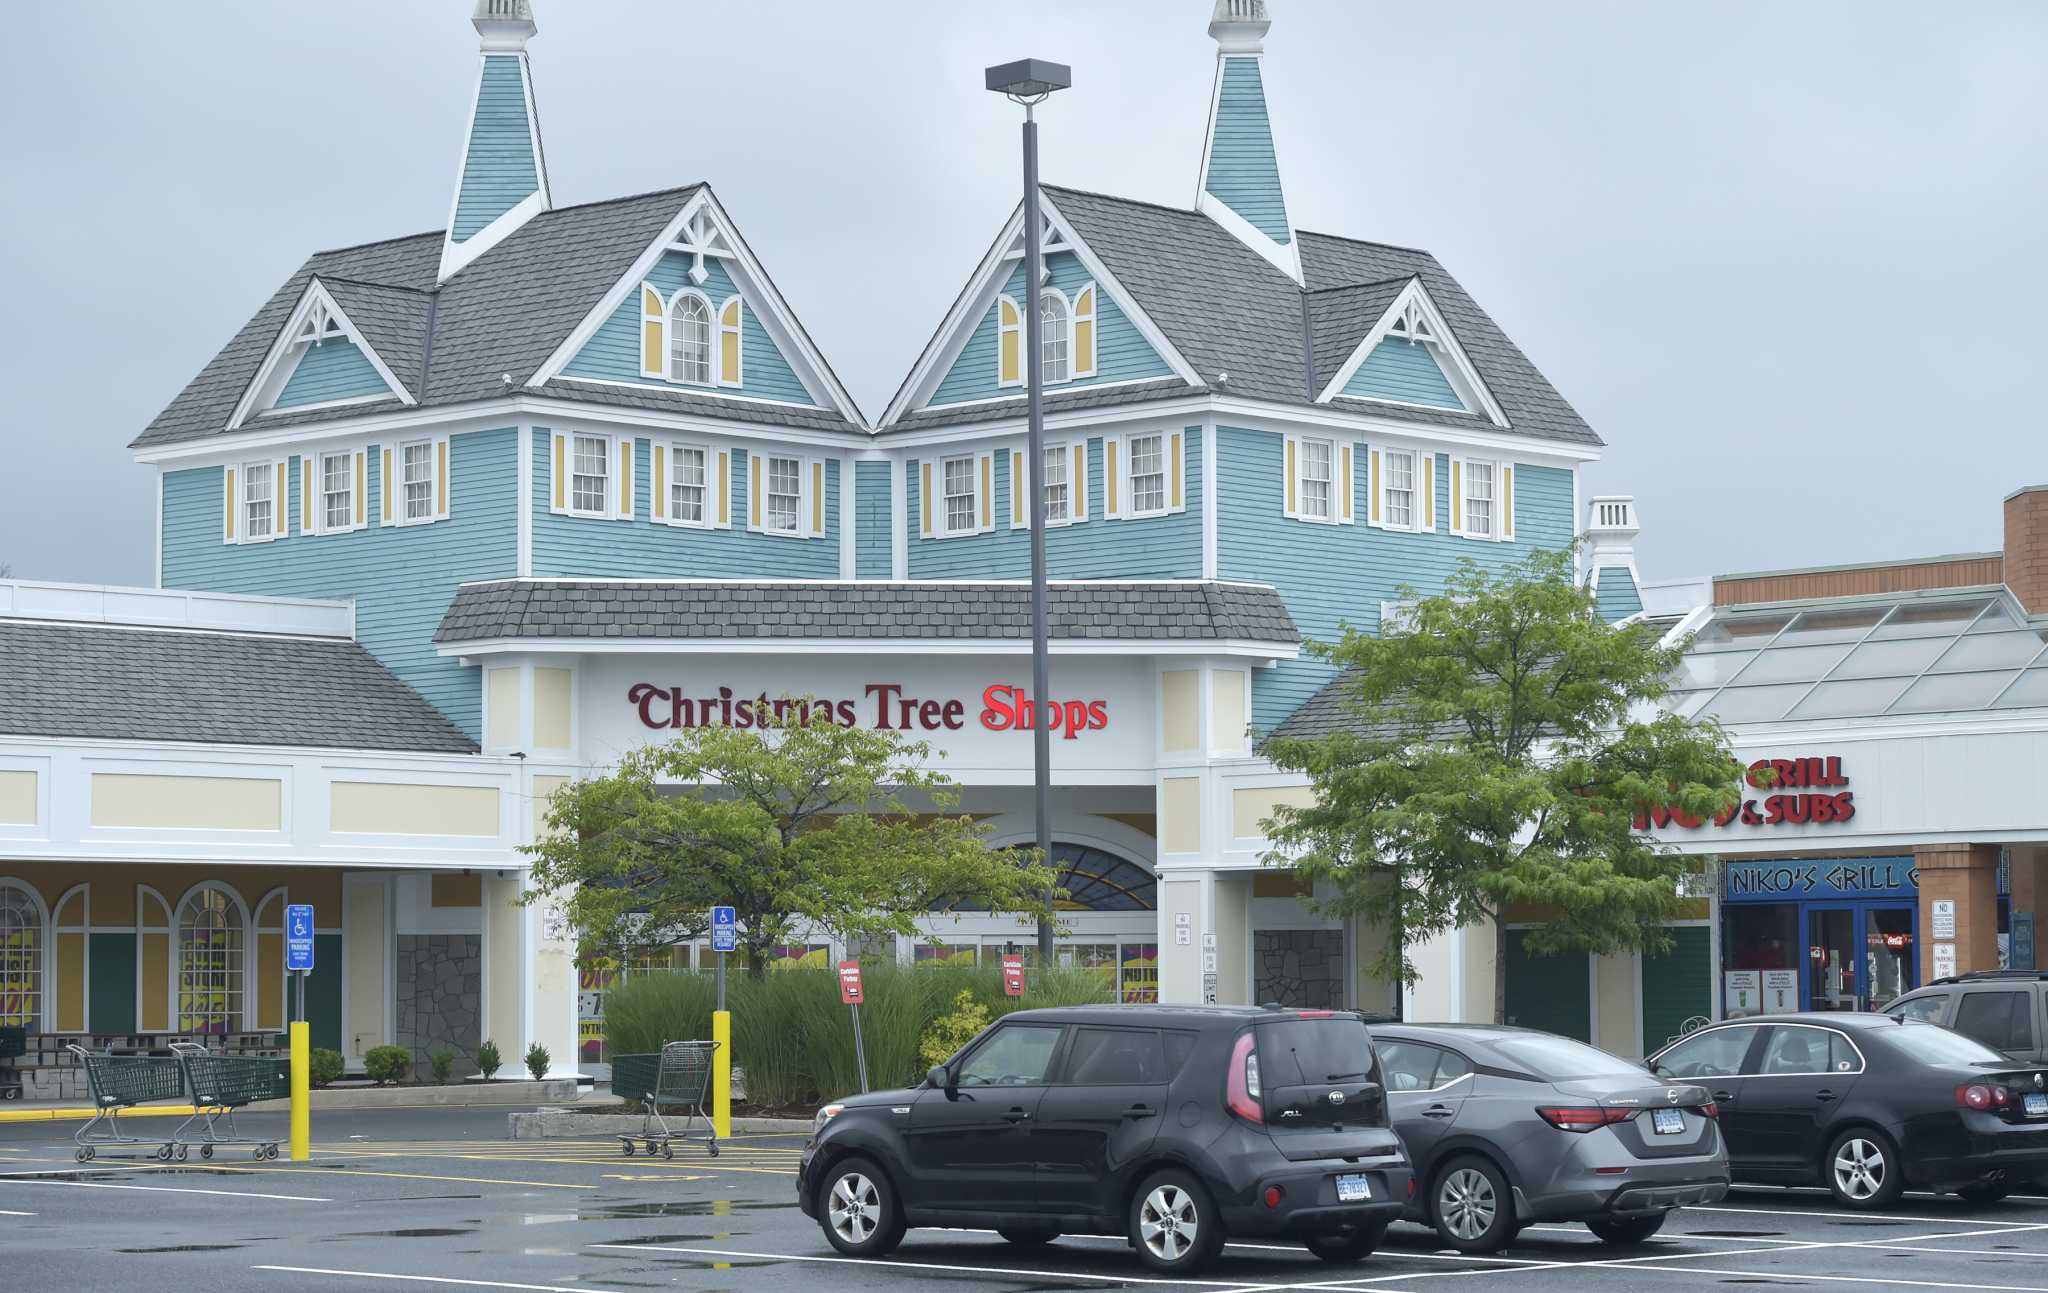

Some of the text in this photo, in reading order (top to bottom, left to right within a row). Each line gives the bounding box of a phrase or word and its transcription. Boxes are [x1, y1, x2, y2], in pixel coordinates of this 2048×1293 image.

[628, 683, 857, 730] Christmas
[865, 684, 964, 730] Tree
[1745, 756, 1849, 788] GRILL
[1741, 792, 1855, 825] & SUBS
[1732, 866, 1816, 894] NIKO'S
[1825, 865, 1899, 890] GRILL
[1939, 904, 1948, 913] NO
